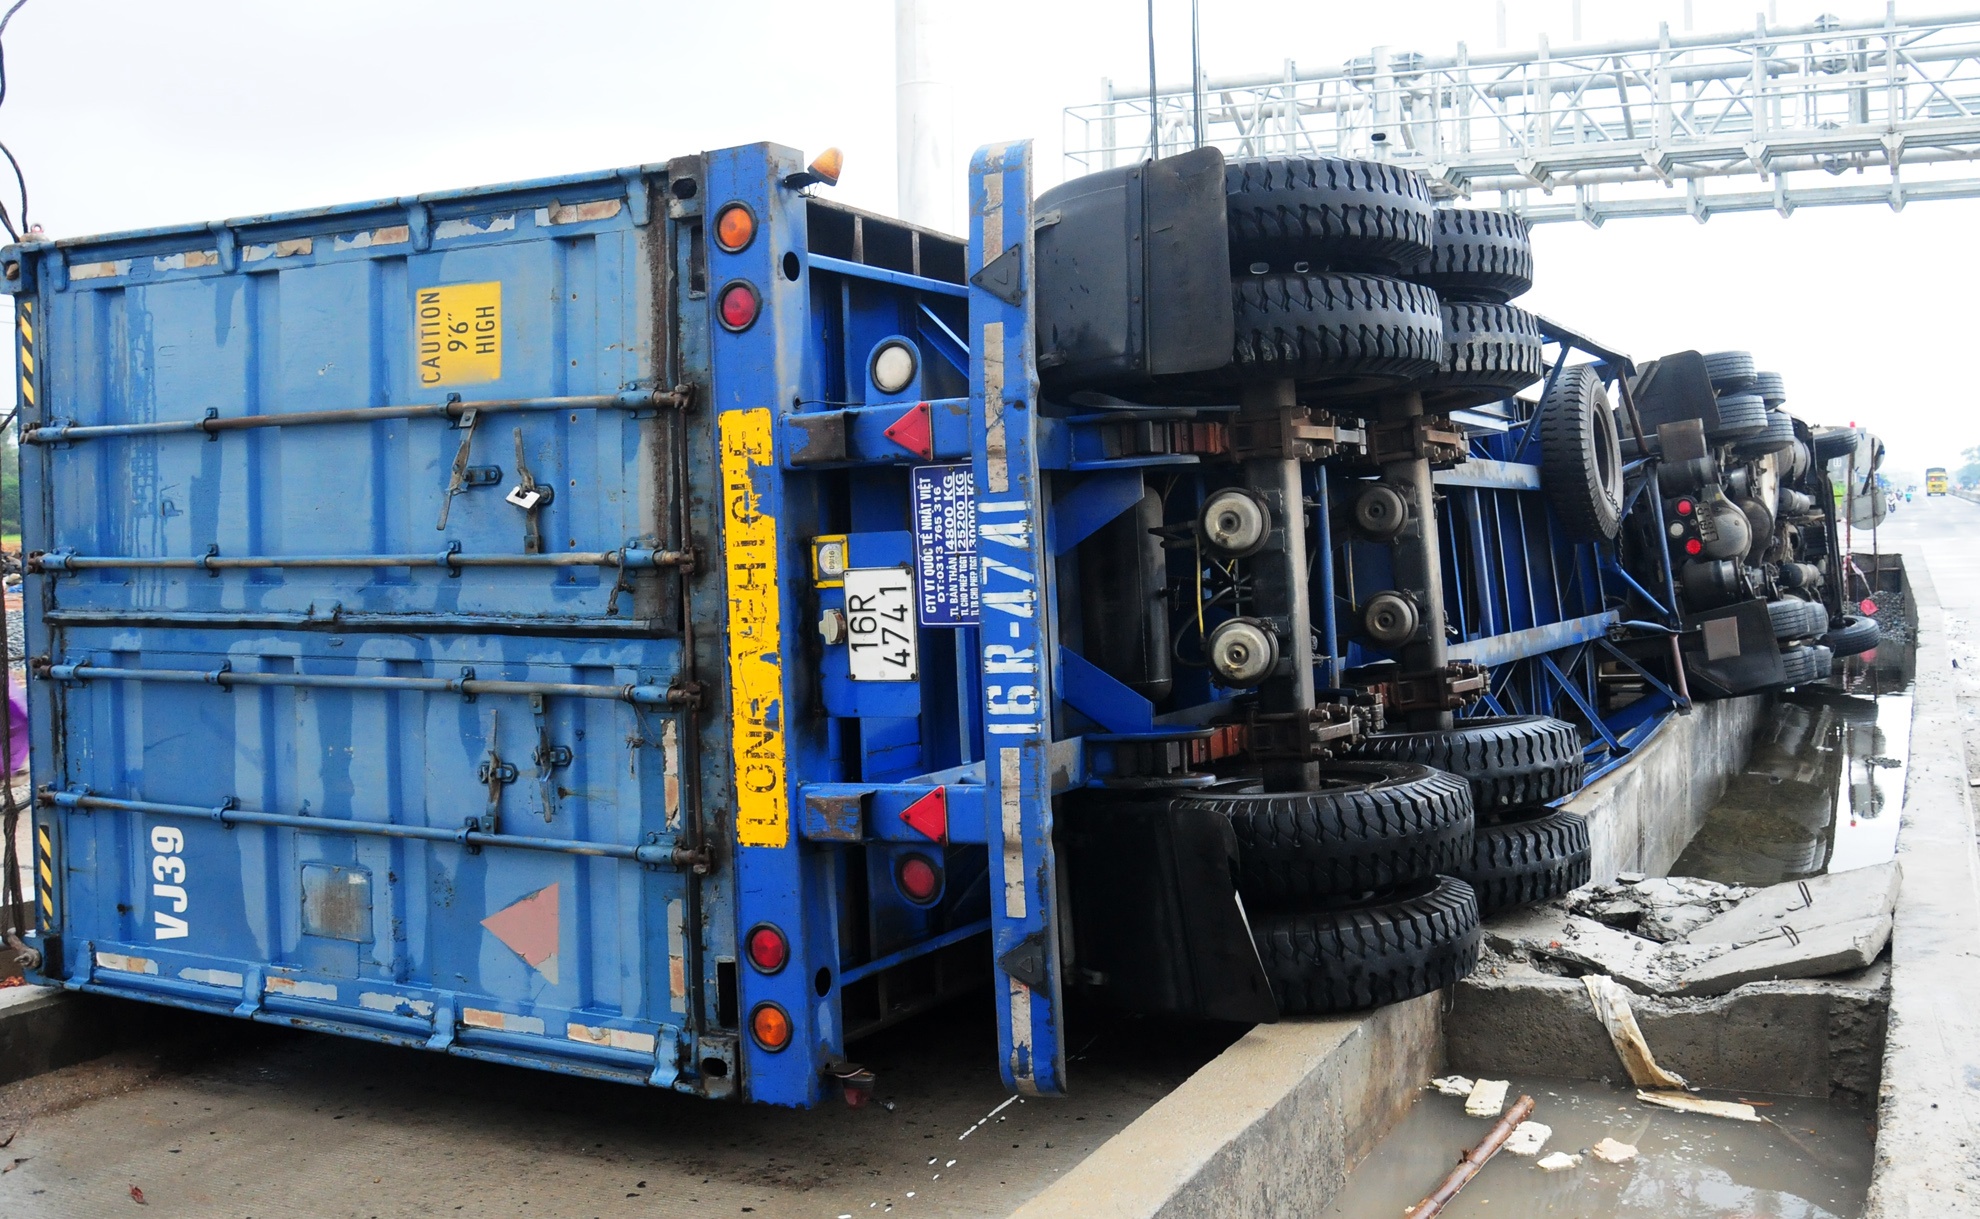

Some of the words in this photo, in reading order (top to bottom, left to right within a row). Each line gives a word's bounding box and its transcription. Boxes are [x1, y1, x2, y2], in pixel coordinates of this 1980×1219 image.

[421, 292, 441, 384] CAUTION
[475, 306, 495, 354] HIGH
[917, 477, 934, 500] VIỆT
[943, 475, 953, 501] KG
[955, 473, 965, 496] KG
[933, 486, 942, 512] 316
[919, 502, 935, 531] NHẬT
[934, 516, 943, 541] 765
[944, 506, 955, 550] 4800
[956, 500, 966, 548] 25200
[968, 500, 977, 548] 30000
[919, 547, 936, 577] QUỐC
[946, 557, 958, 583] THÂN
[959, 556, 968, 573] TGGT
[924, 578, 936, 592] VT
[946, 584, 959, 604] BẢN
[970, 587, 979, 600] CHO
[925, 594, 937, 614] CTY
[949, 605, 959, 617] TL
[960, 592, 969, 607] CHO
[960, 608, 969, 617] TL
[970, 608, 980, 617] TL
[848, 594, 878, 653] 16R
[879, 586, 910, 668] 4741
[977, 501, 1042, 735] 16R-4741
[151, 825, 189, 940] VJ39
